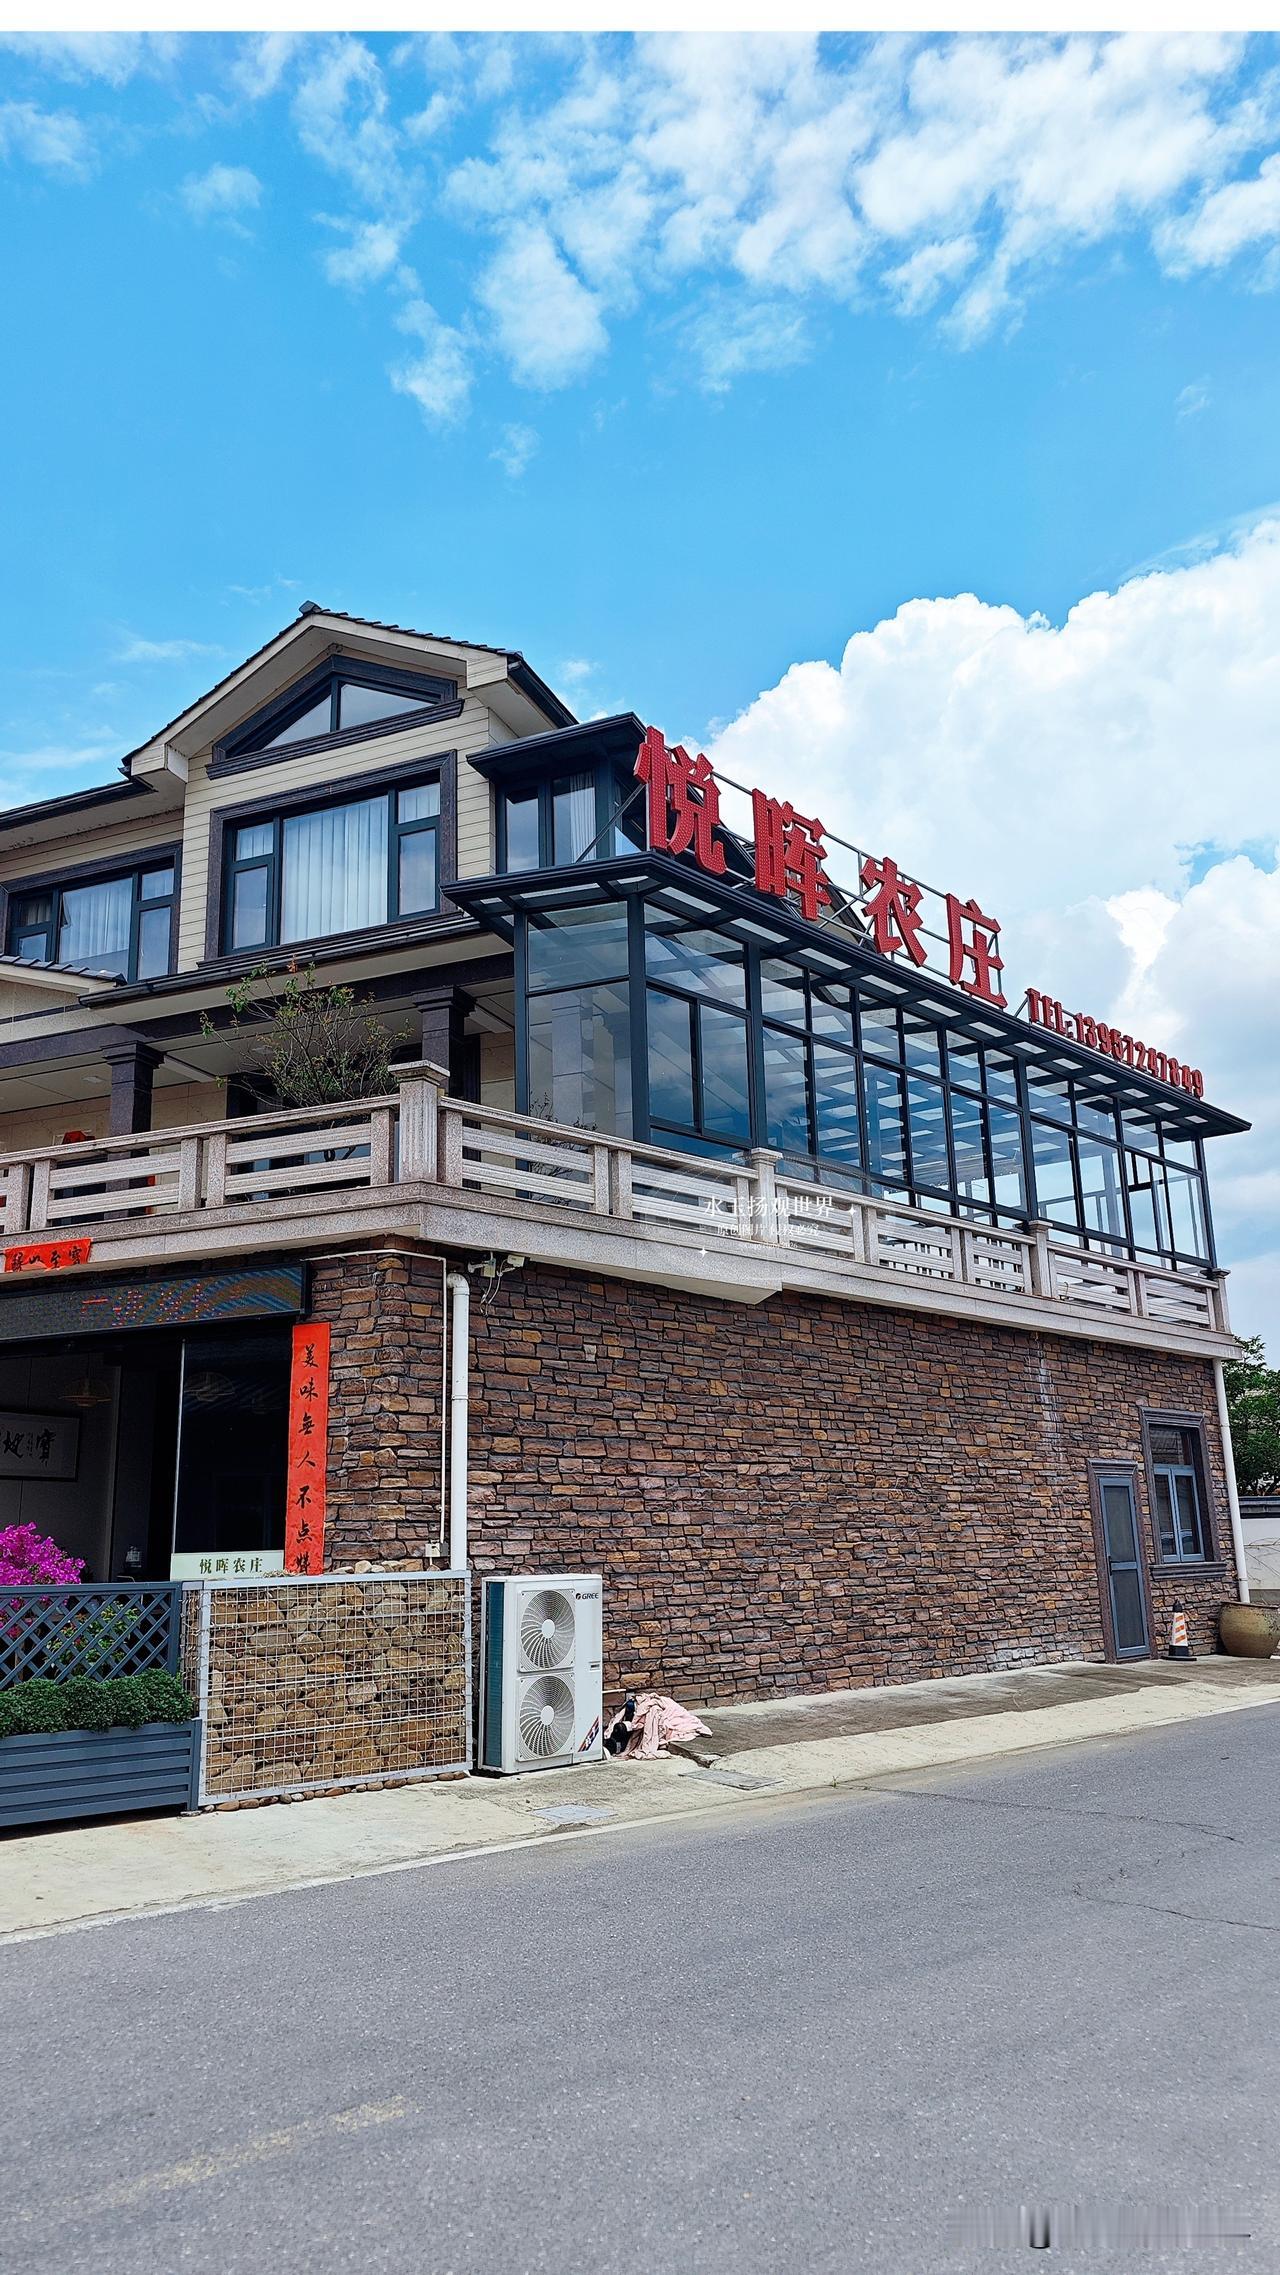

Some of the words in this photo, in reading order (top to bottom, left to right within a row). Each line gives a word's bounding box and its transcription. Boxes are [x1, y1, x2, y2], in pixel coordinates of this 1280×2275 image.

[634, 726, 1007, 1008] 悦晖农庄
[199, 1557, 263, 1574] 悦晖农庄
[582, 1592, 599, 1600] GREE
